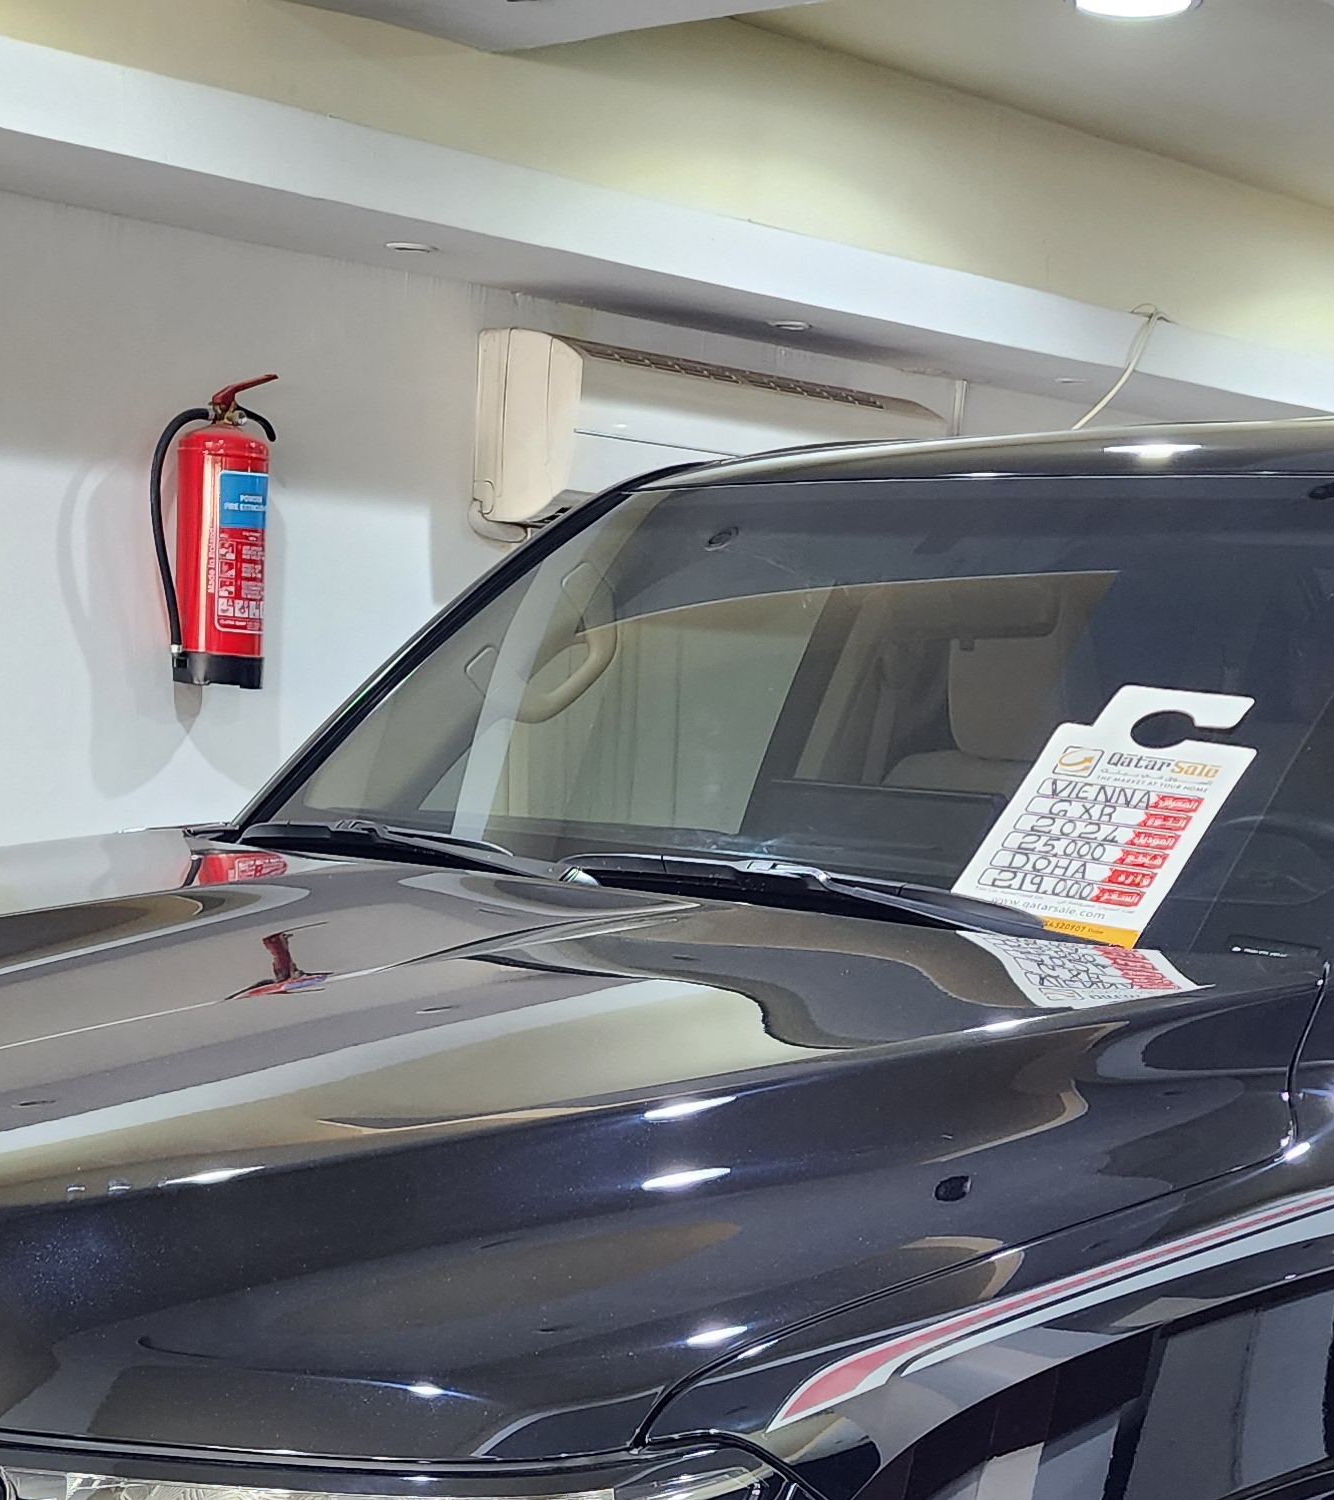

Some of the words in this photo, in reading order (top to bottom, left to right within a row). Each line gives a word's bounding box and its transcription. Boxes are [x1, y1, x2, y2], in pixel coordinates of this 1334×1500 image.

[1051, 779, 1151, 810] VIENNA
[1097, 774, 1111, 782] THE
[1114, 776, 1145, 786] MARKET
[1146, 779, 1158, 788] AT
[1159, 781, 1181, 790] YOUR
[1182, 784, 1209, 794] HOME
[1030, 815, 1119, 844] 2024
[1007, 853, 1088, 880] DOHA
